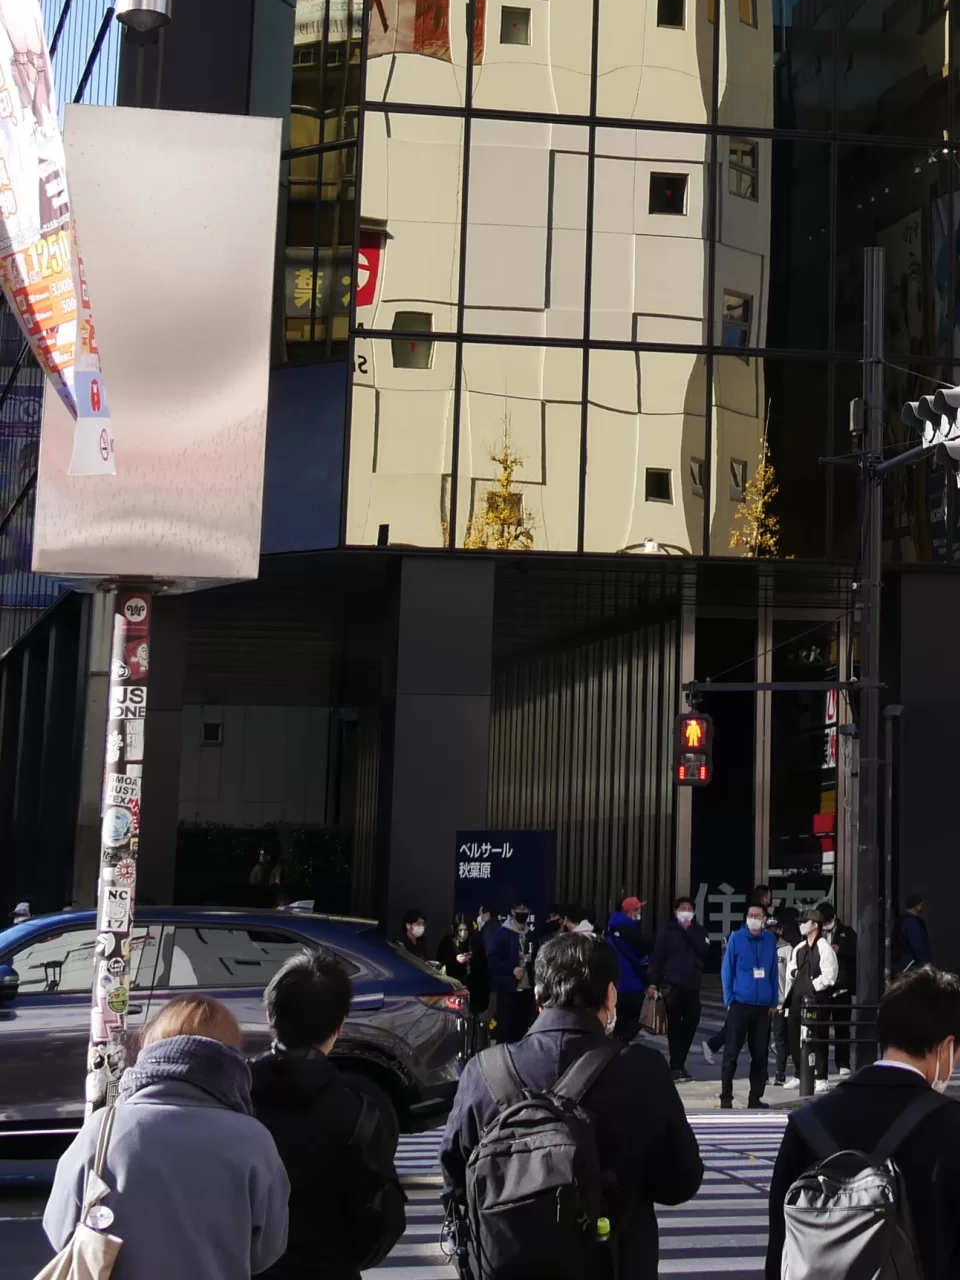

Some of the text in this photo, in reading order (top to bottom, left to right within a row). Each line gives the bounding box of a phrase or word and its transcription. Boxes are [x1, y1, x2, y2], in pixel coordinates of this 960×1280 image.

[459, 841, 513, 859] ベルサール
[458, 861, 491, 879] 秋葉原
[108, 890, 128, 901] NC
[106, 920, 124, 929] 17
